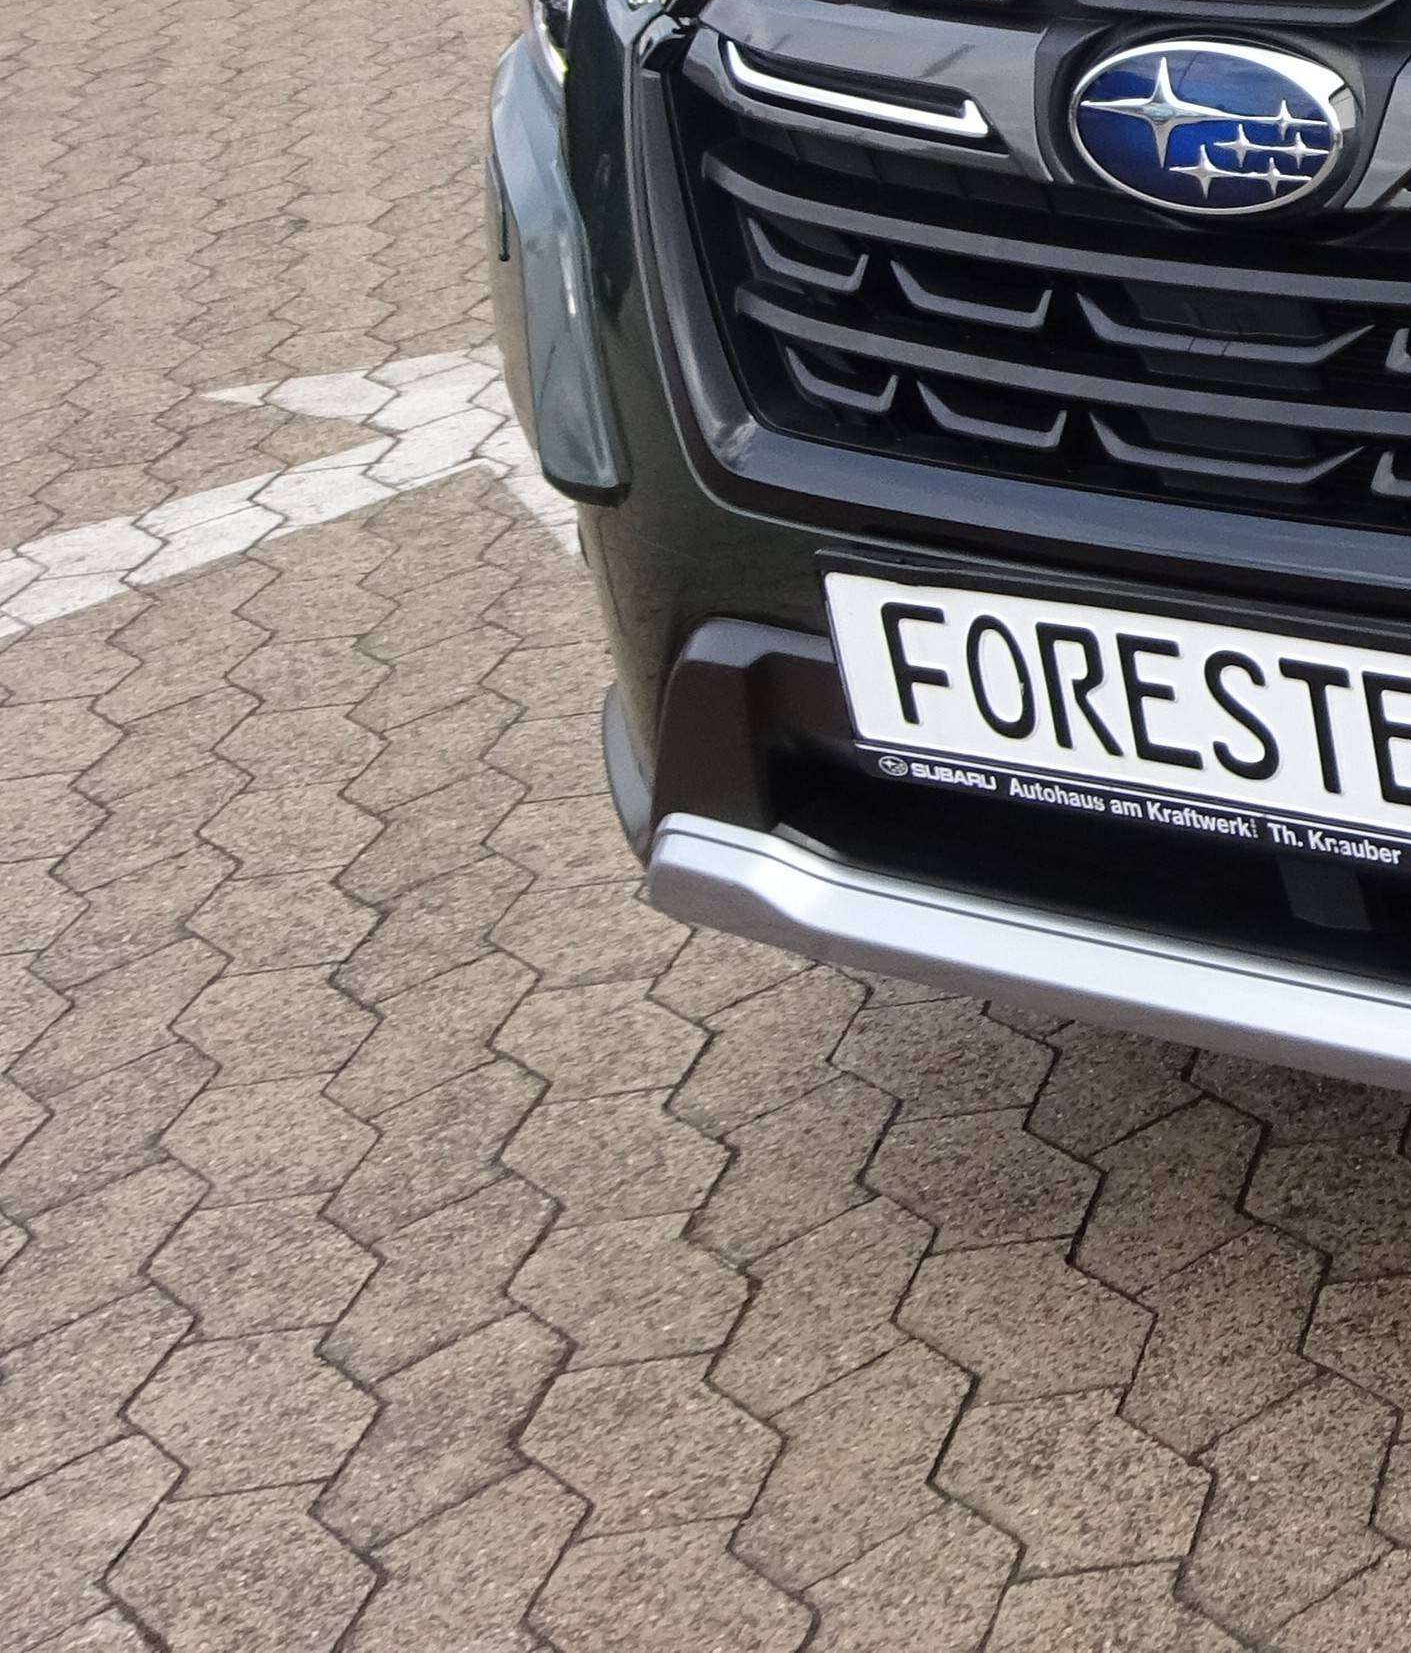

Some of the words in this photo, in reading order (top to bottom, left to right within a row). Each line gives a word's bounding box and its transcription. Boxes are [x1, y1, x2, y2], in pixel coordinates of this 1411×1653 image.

[910, 762, 997, 791] SUBARU
[1009, 777, 1106, 812] Autohaus
[1110, 799, 1143, 818] am
[1146, 800, 1253, 838] Kraftwerk
[1266, 821, 1304, 848] Th.
